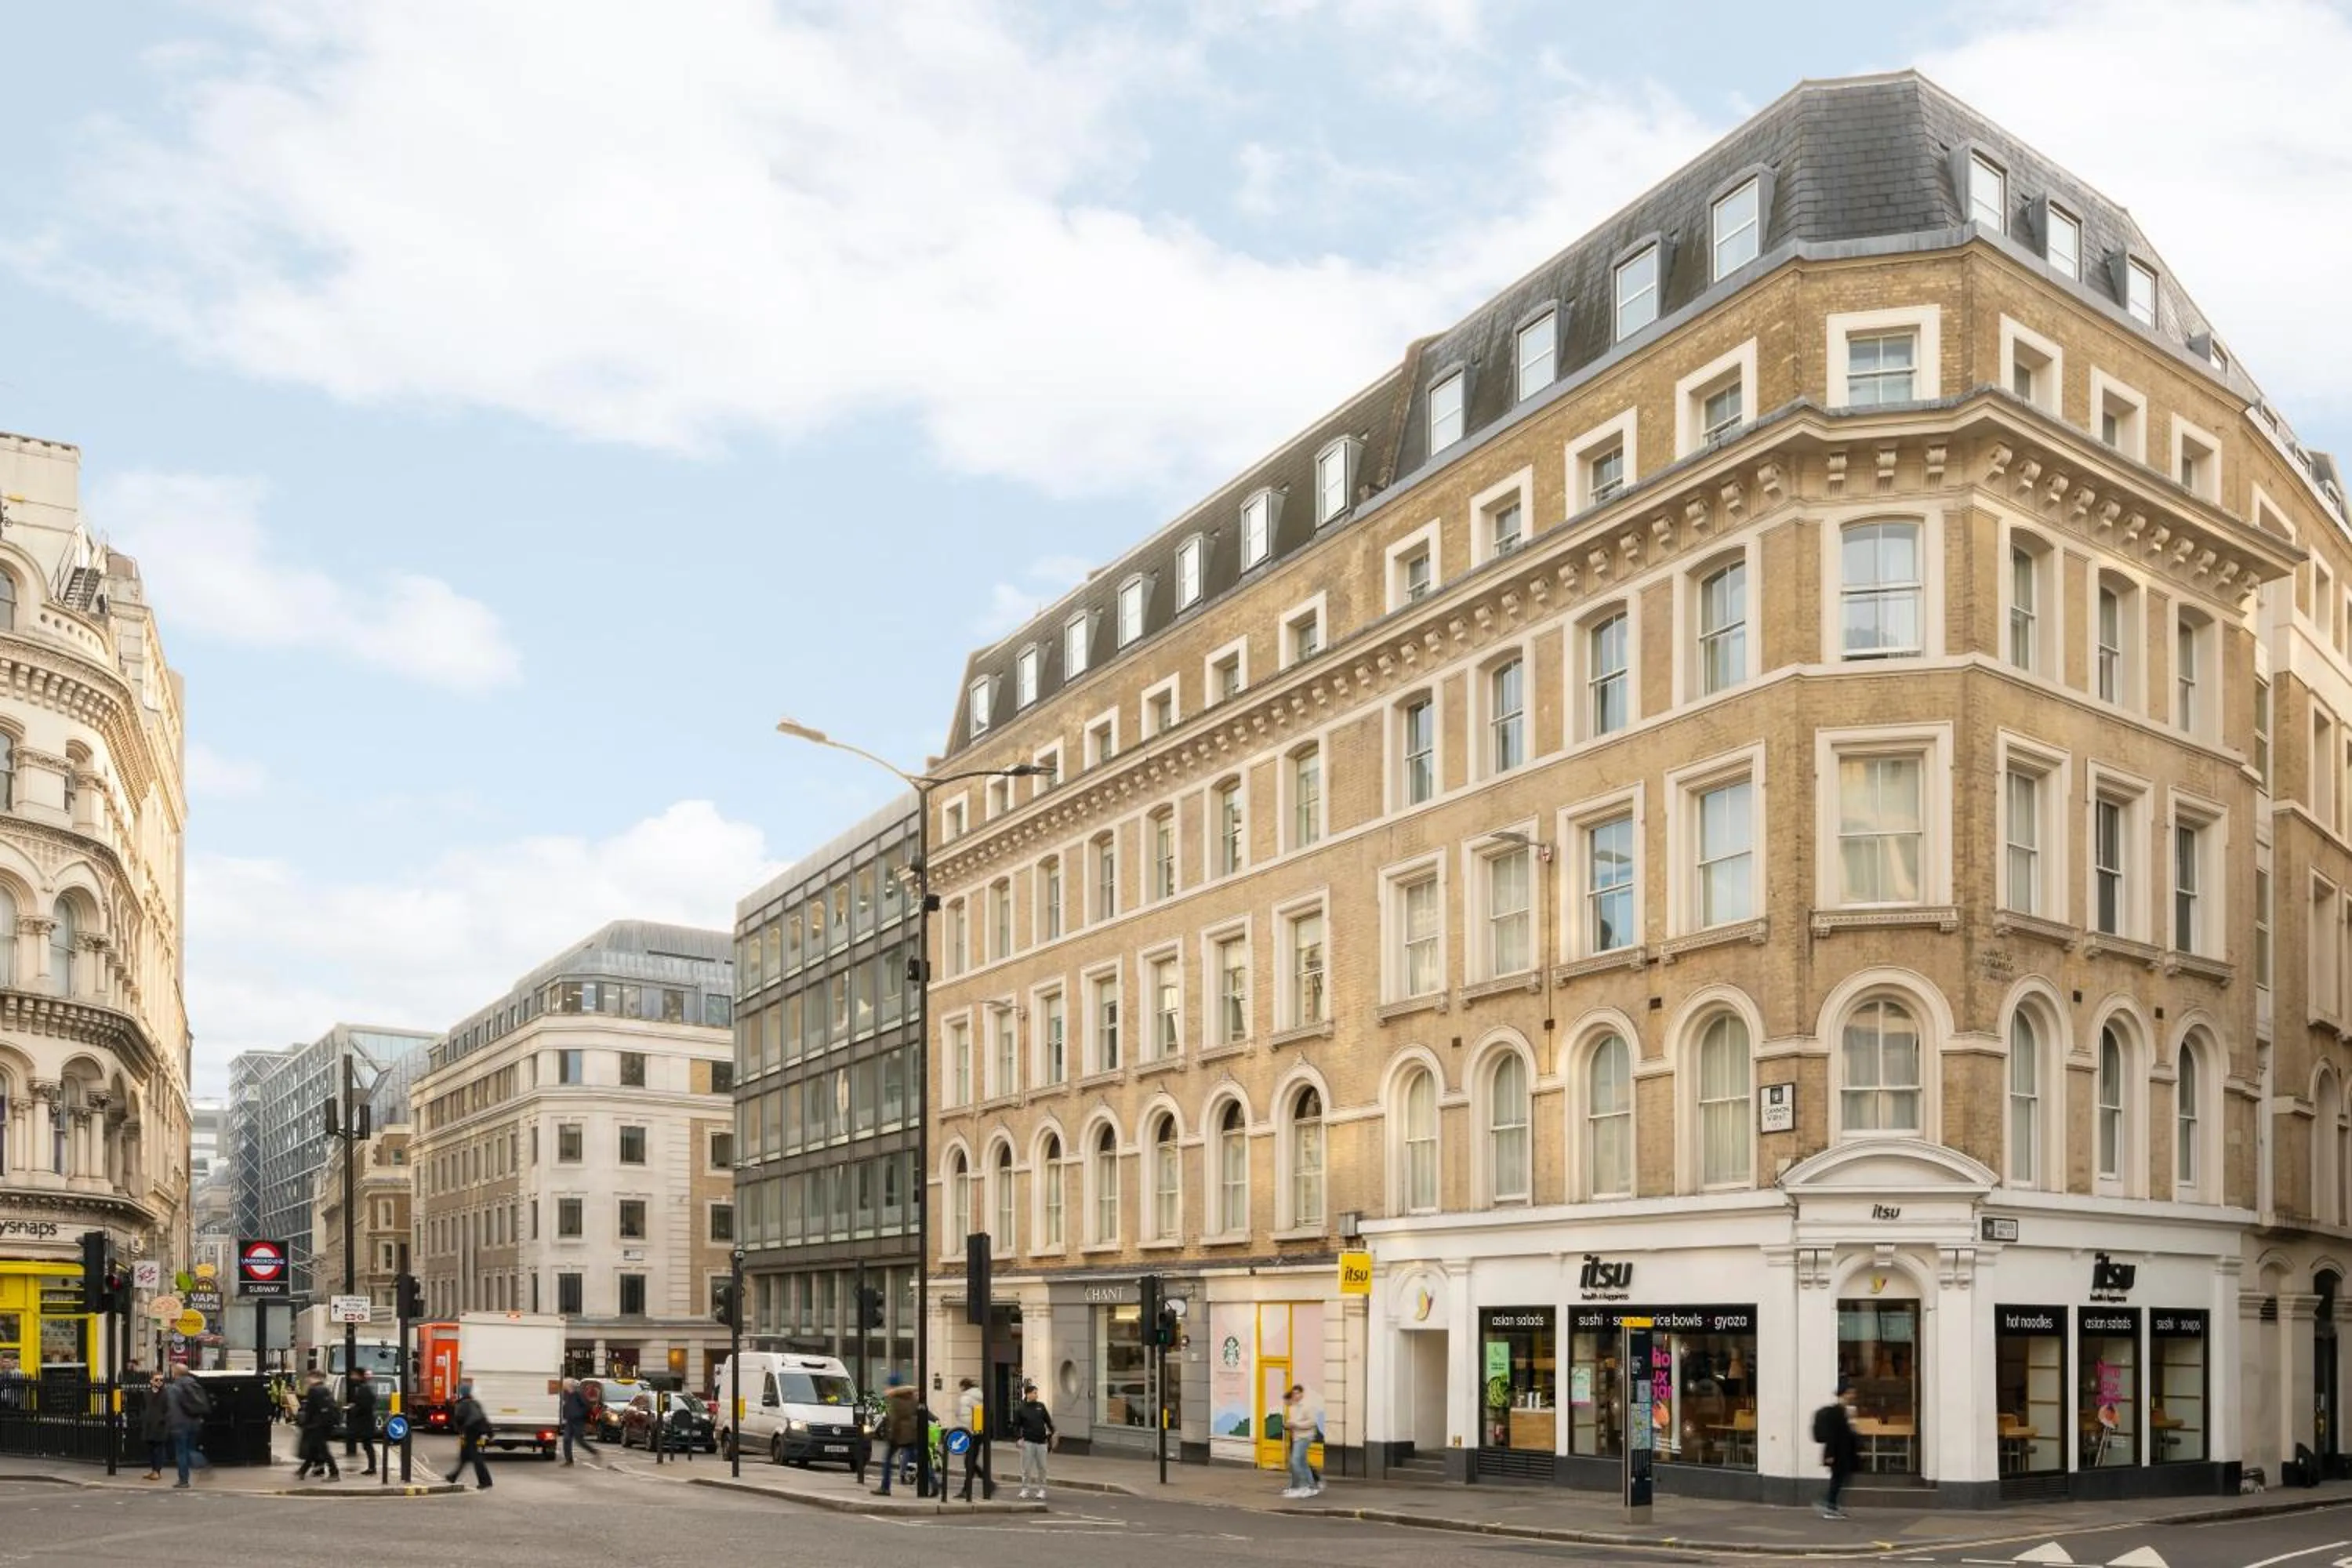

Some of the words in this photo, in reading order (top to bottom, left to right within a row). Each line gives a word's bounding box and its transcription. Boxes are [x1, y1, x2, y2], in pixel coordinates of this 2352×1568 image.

[1872, 1204, 1900, 1220] itsu
[1345, 1266, 1368, 1282] itsu
[1581, 1254, 1632, 1288] itsu
[2092, 1252, 2136, 1290] itsu
[191, 1292, 220, 1302] VAPE
[1492, 1313, 1514, 1326] asian
[1516, 1312, 1544, 1326] salads
[1578, 1311, 1603, 1326] sushi
[1653, 1313, 1671, 1327] rice
[1672, 1312, 1702, 1327] bowls
[1715, 1316, 1747, 1330] gyoza
[2006, 1314, 2019, 1327] hot
[2020, 1313, 2053, 1329] noodles
[2085, 1316, 2106, 1330] asian
[2107, 1316, 2132, 1330] salads
